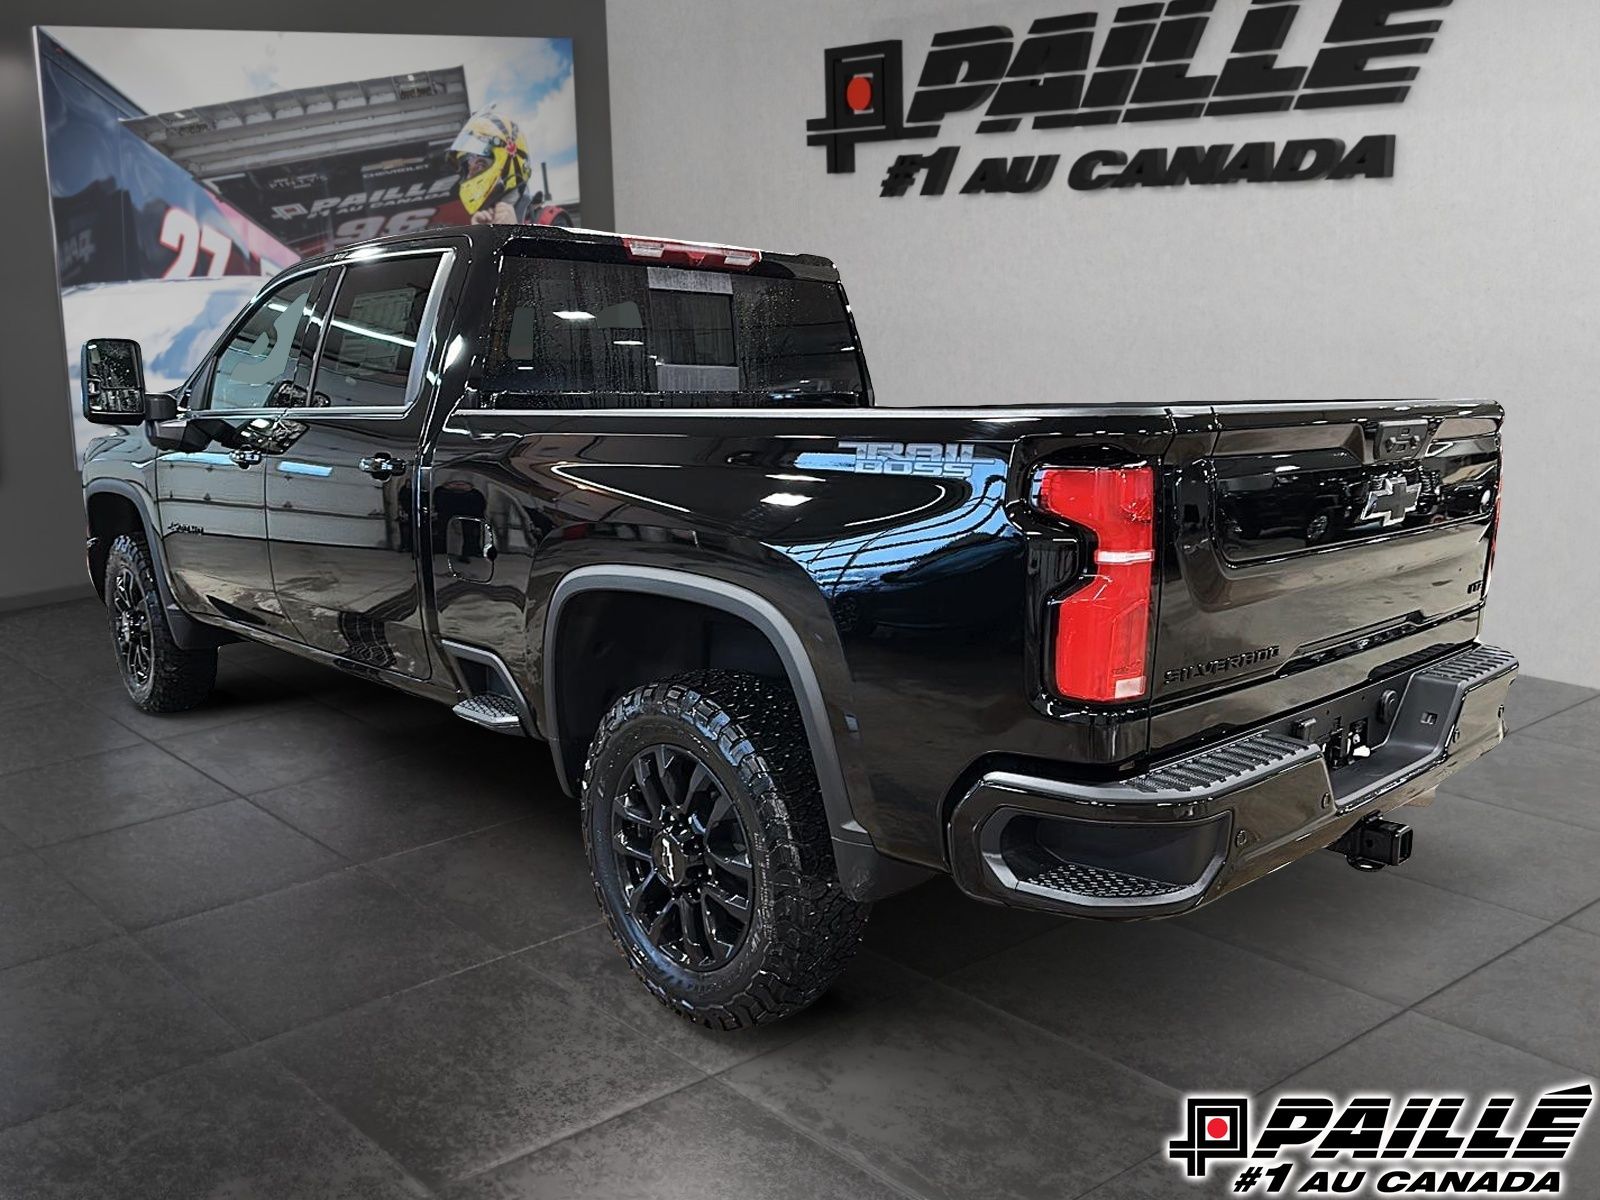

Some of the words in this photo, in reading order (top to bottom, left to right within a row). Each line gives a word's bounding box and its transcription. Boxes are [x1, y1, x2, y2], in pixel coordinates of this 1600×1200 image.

[879, 146, 960, 197] #1
[959, 154, 1060, 194] AU
[1068, 134, 1396, 190] CANADA
[160, 206, 232, 280] 27
[336, 208, 437, 244] 96
[838, 441, 995, 465] TRAIL
[854, 459, 973, 478] BOSS
